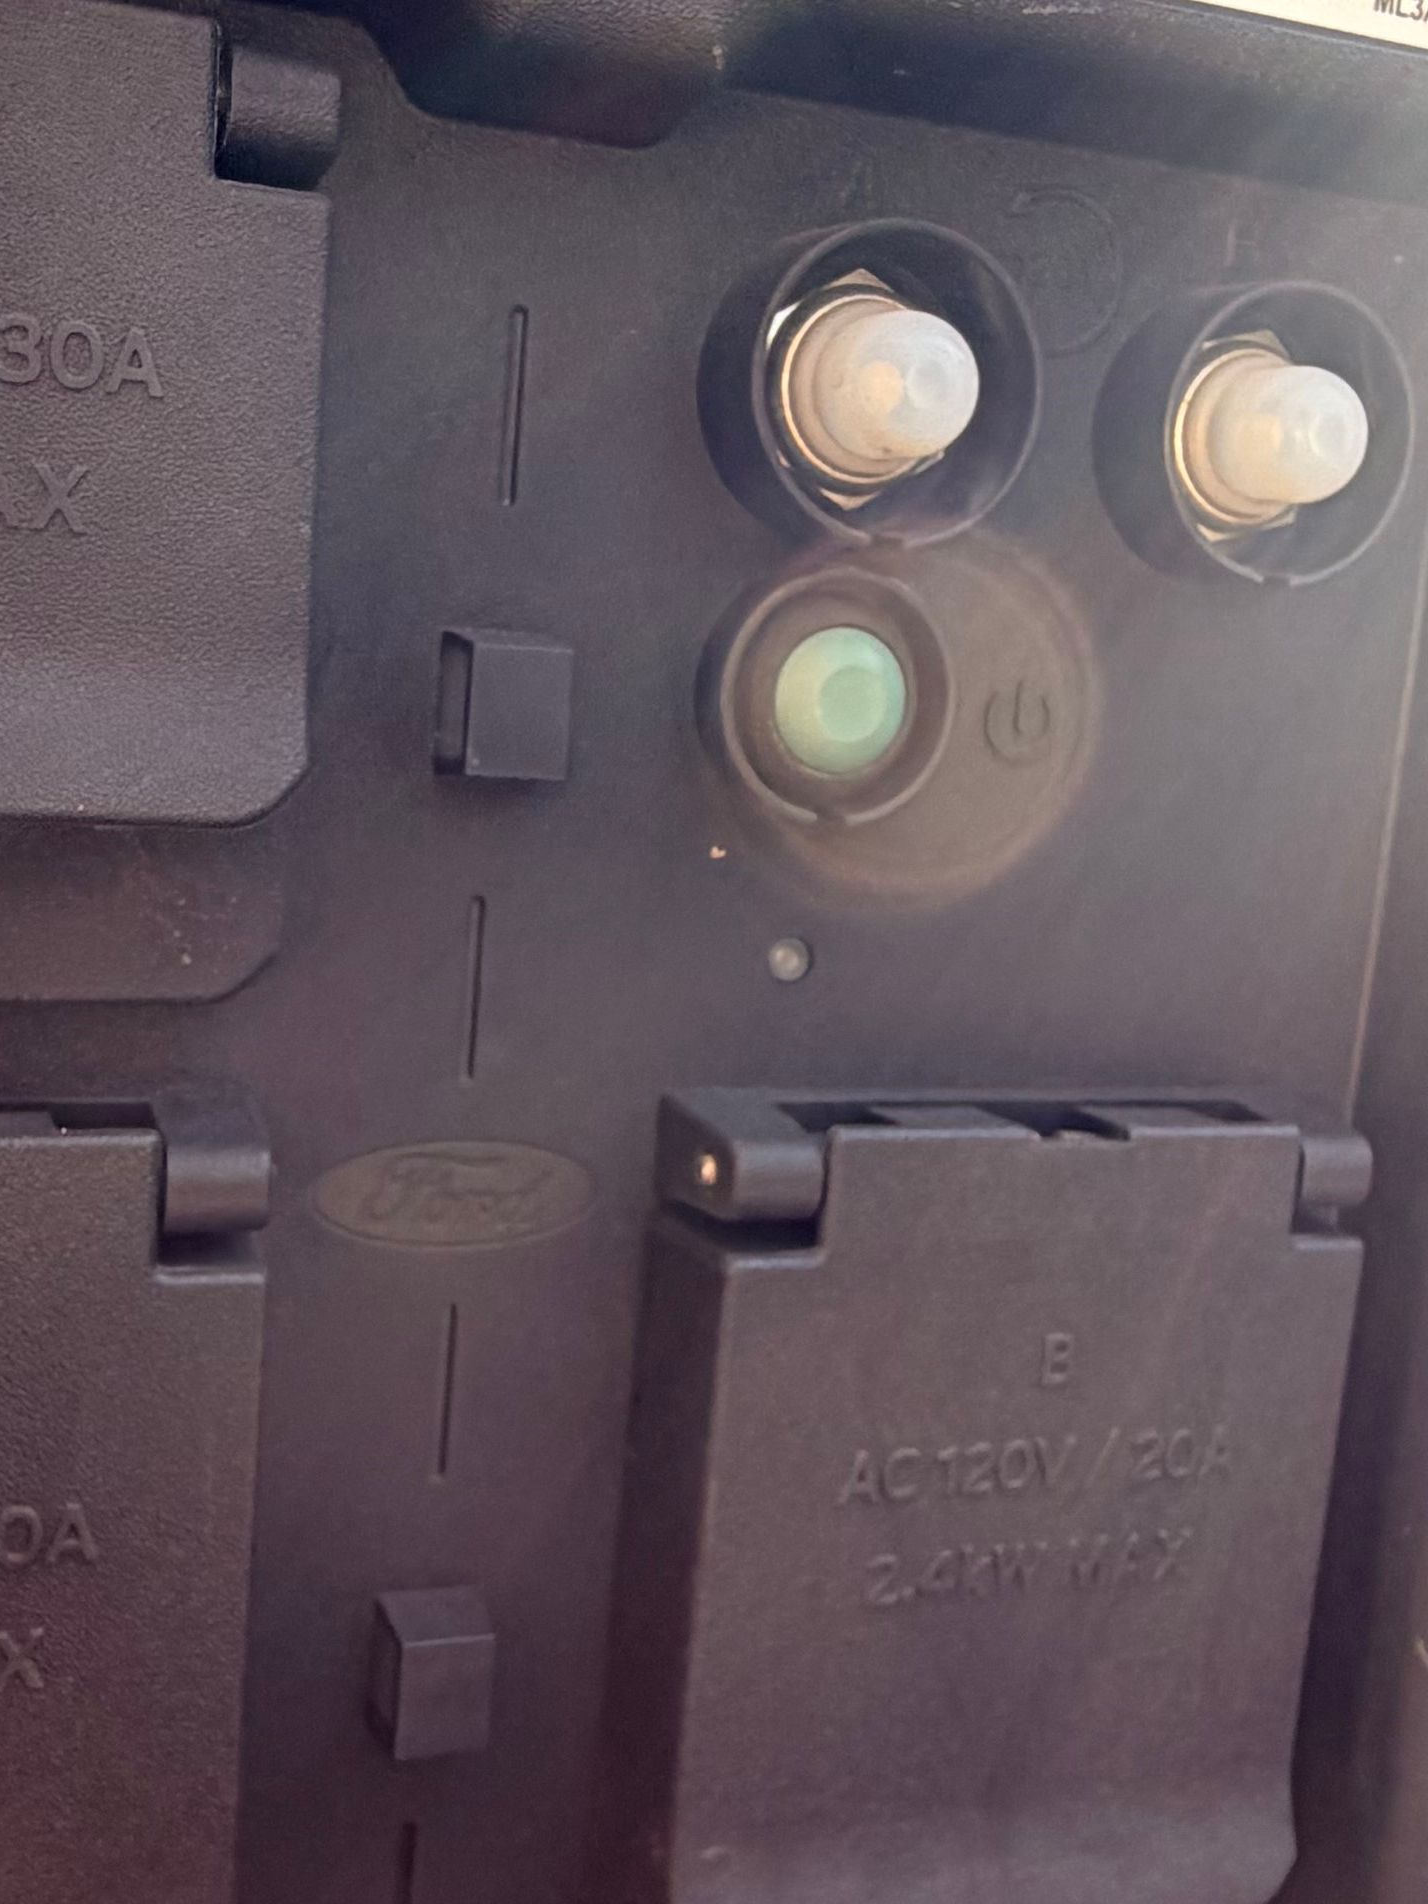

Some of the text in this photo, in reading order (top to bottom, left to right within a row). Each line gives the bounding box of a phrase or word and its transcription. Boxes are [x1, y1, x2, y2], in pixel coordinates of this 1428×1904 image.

[1038, 1330, 1072, 1388] B
[838, 1448, 921, 1504] AC
[937, 1435, 1077, 1496] 120V
